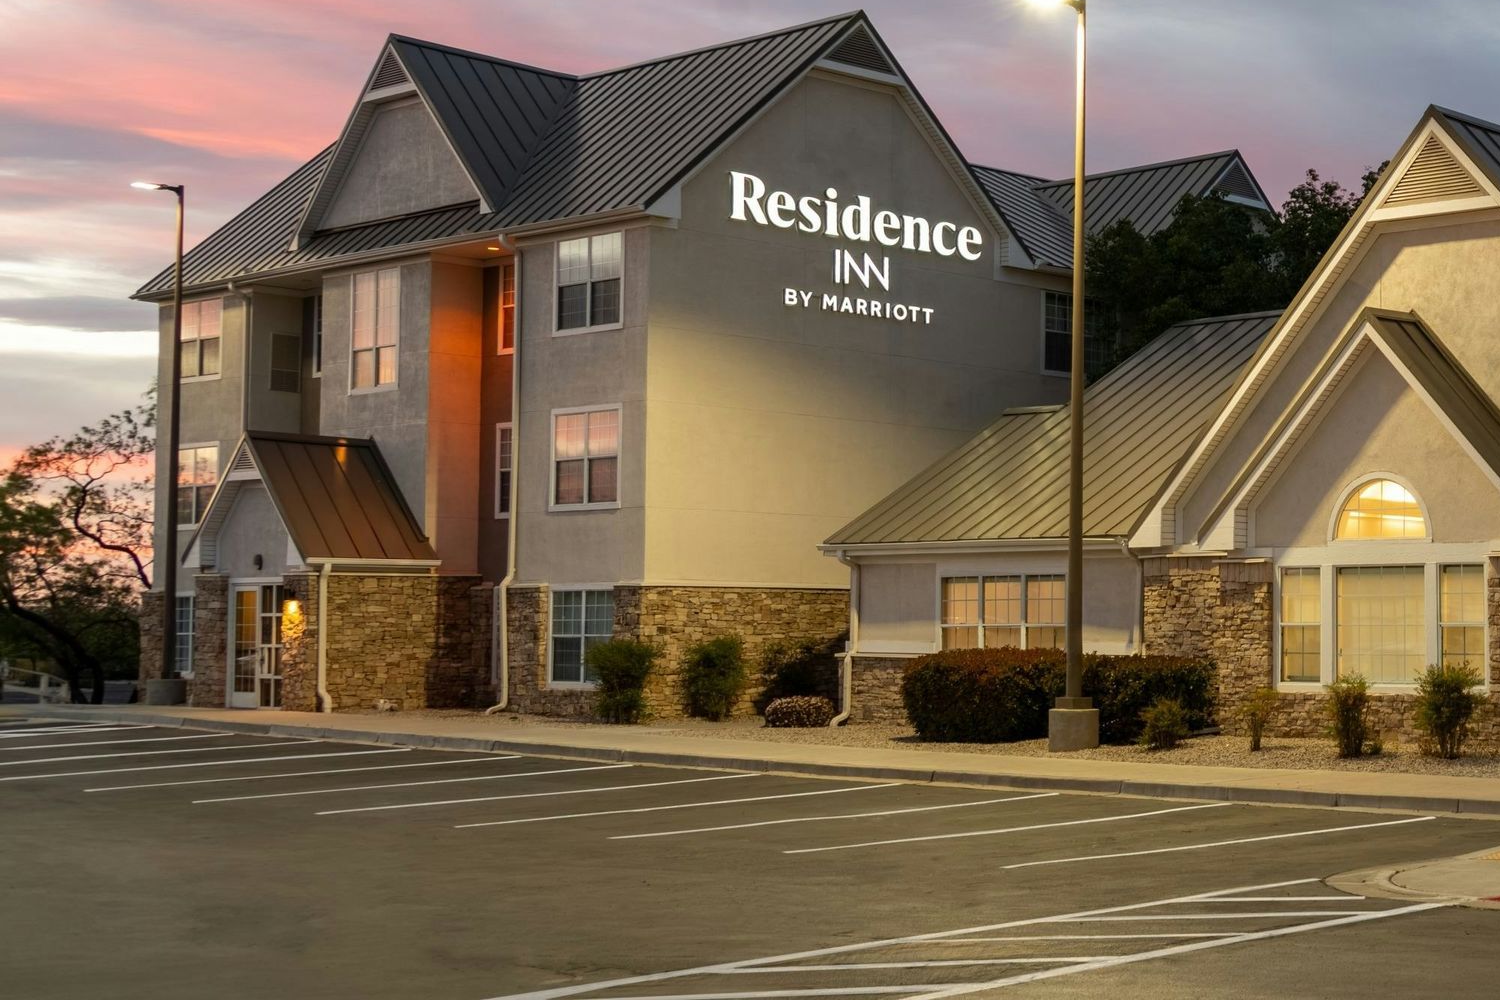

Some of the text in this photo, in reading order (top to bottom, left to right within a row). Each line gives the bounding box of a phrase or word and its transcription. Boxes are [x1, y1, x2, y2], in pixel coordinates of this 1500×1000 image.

[729, 170, 983, 261] Residence
[834, 248, 890, 291] INN
[784, 288, 934, 324] BY MARRIOTT
